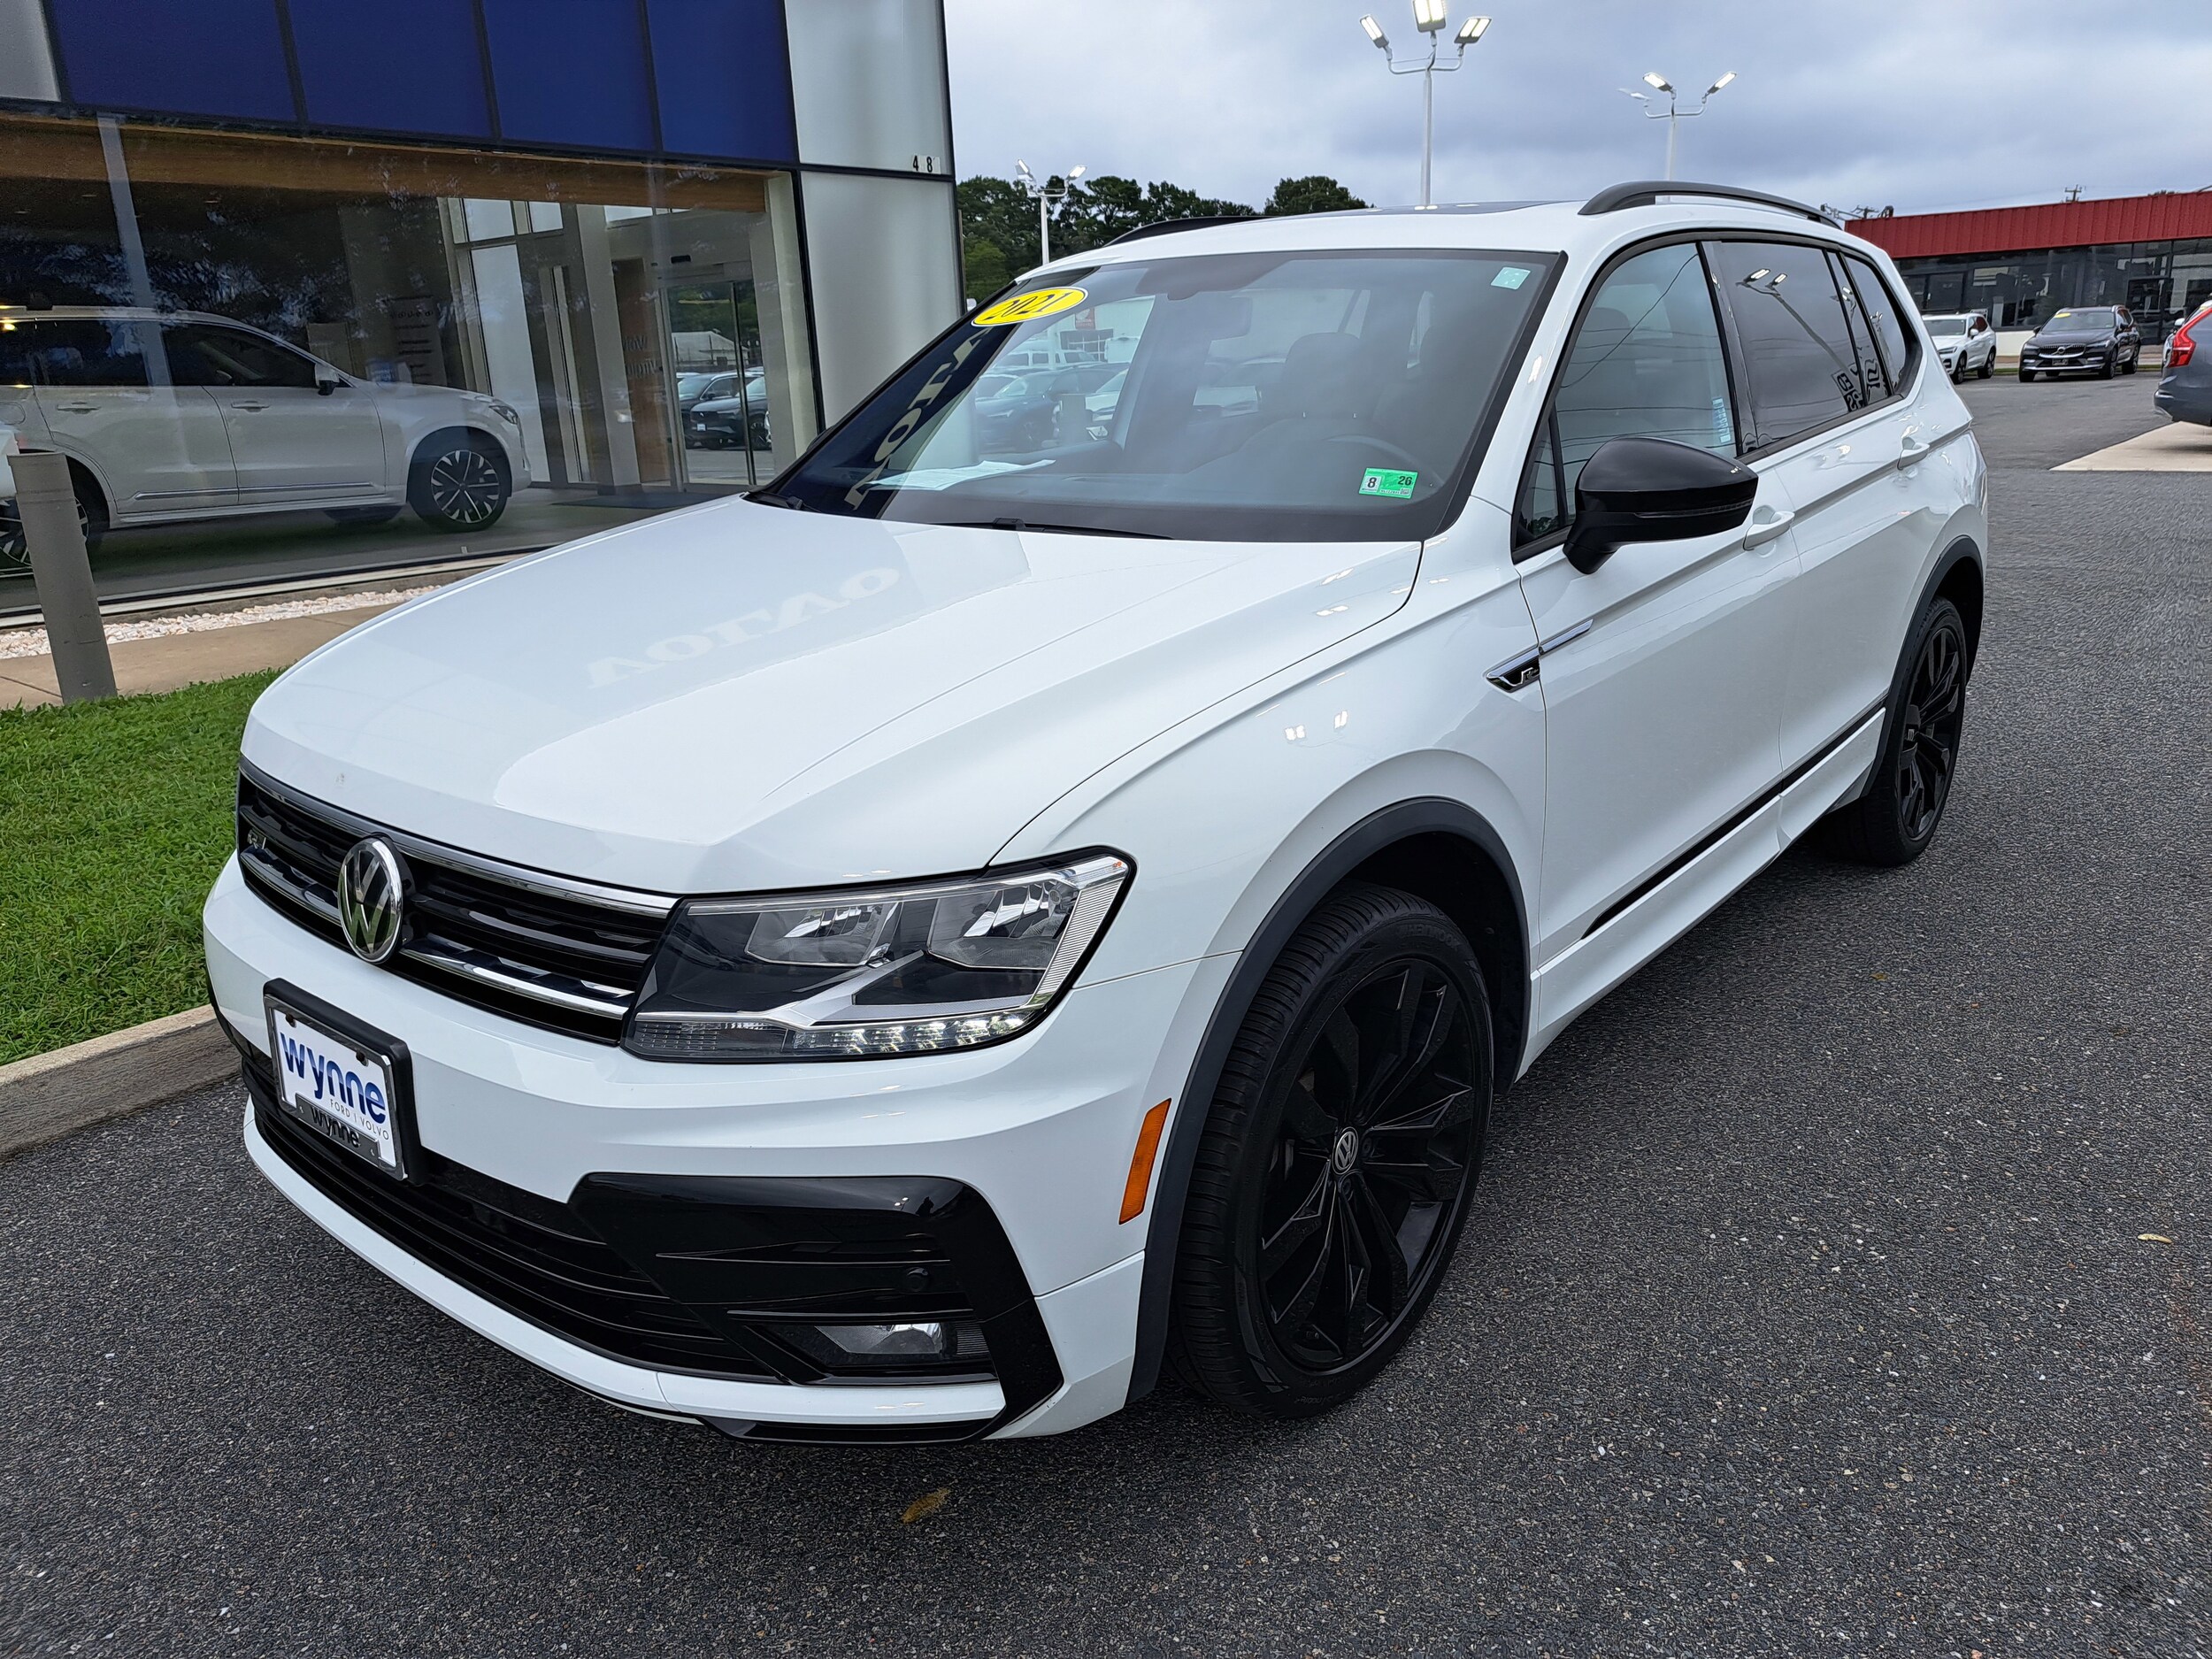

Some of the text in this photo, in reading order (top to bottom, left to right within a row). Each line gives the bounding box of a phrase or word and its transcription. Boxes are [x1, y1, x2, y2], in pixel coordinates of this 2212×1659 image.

[983, 291, 1073, 321] 2021
[1368, 476, 1413, 488] 8 26
[280, 1032, 386, 1125] wynne
[311, 1106, 361, 1148] wynne
[330, 1099, 389, 1141] FORD VOLVO
